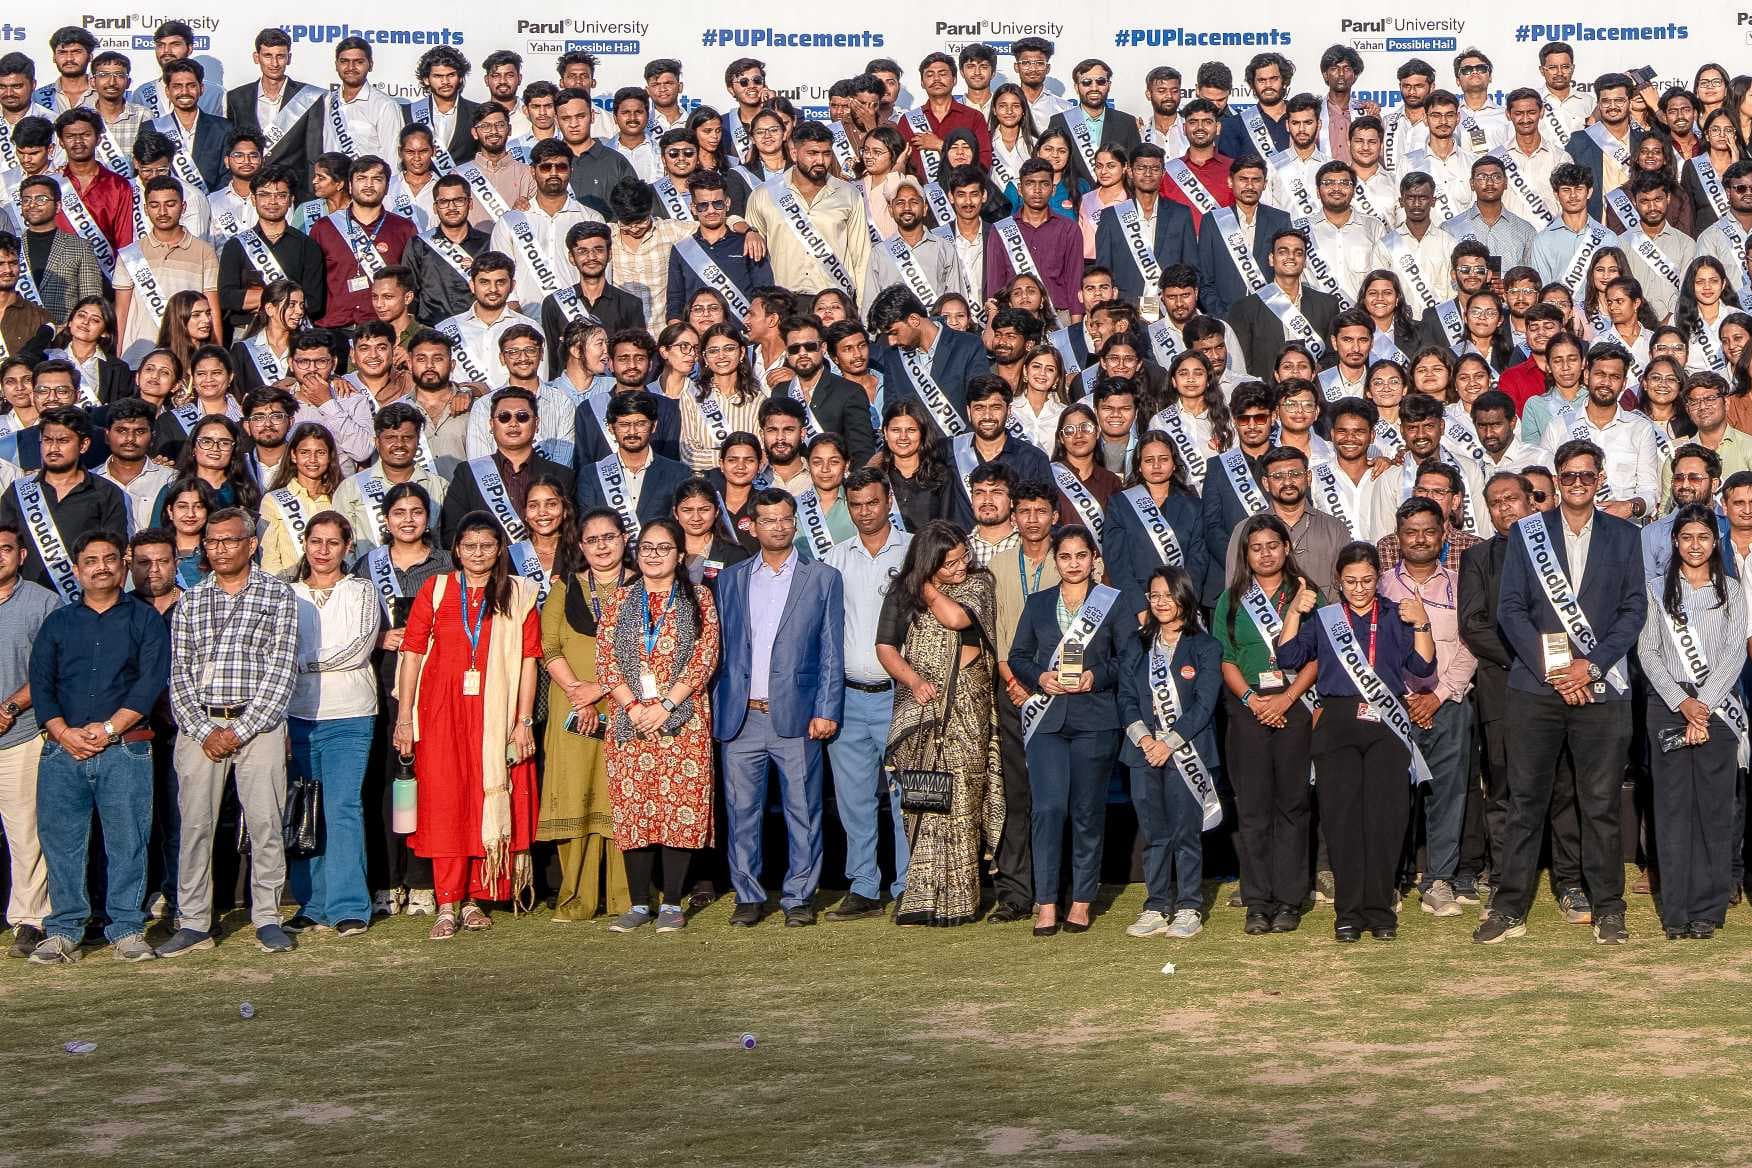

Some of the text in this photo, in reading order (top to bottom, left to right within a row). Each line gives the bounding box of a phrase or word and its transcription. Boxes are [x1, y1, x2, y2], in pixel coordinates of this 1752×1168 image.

[574, 20, 649, 36] University
[990, 21, 1063, 38] University
[1395, 18, 1465, 35] University
[1515, 23, 1688, 42] #PUPlacements
[702, 28, 884, 47] #PUPlacements
[1115, 28, 1292, 47] #PUPlacements
[1353, 39, 1384, 50] Yahan
[1388, 38, 1431, 50] Possible
[529, 42, 637, 53] Yahan Possible Hai!
[776, 194, 857, 297] #ProudlyPlace
[1520, 518, 1598, 650] #ProudlyPlace
